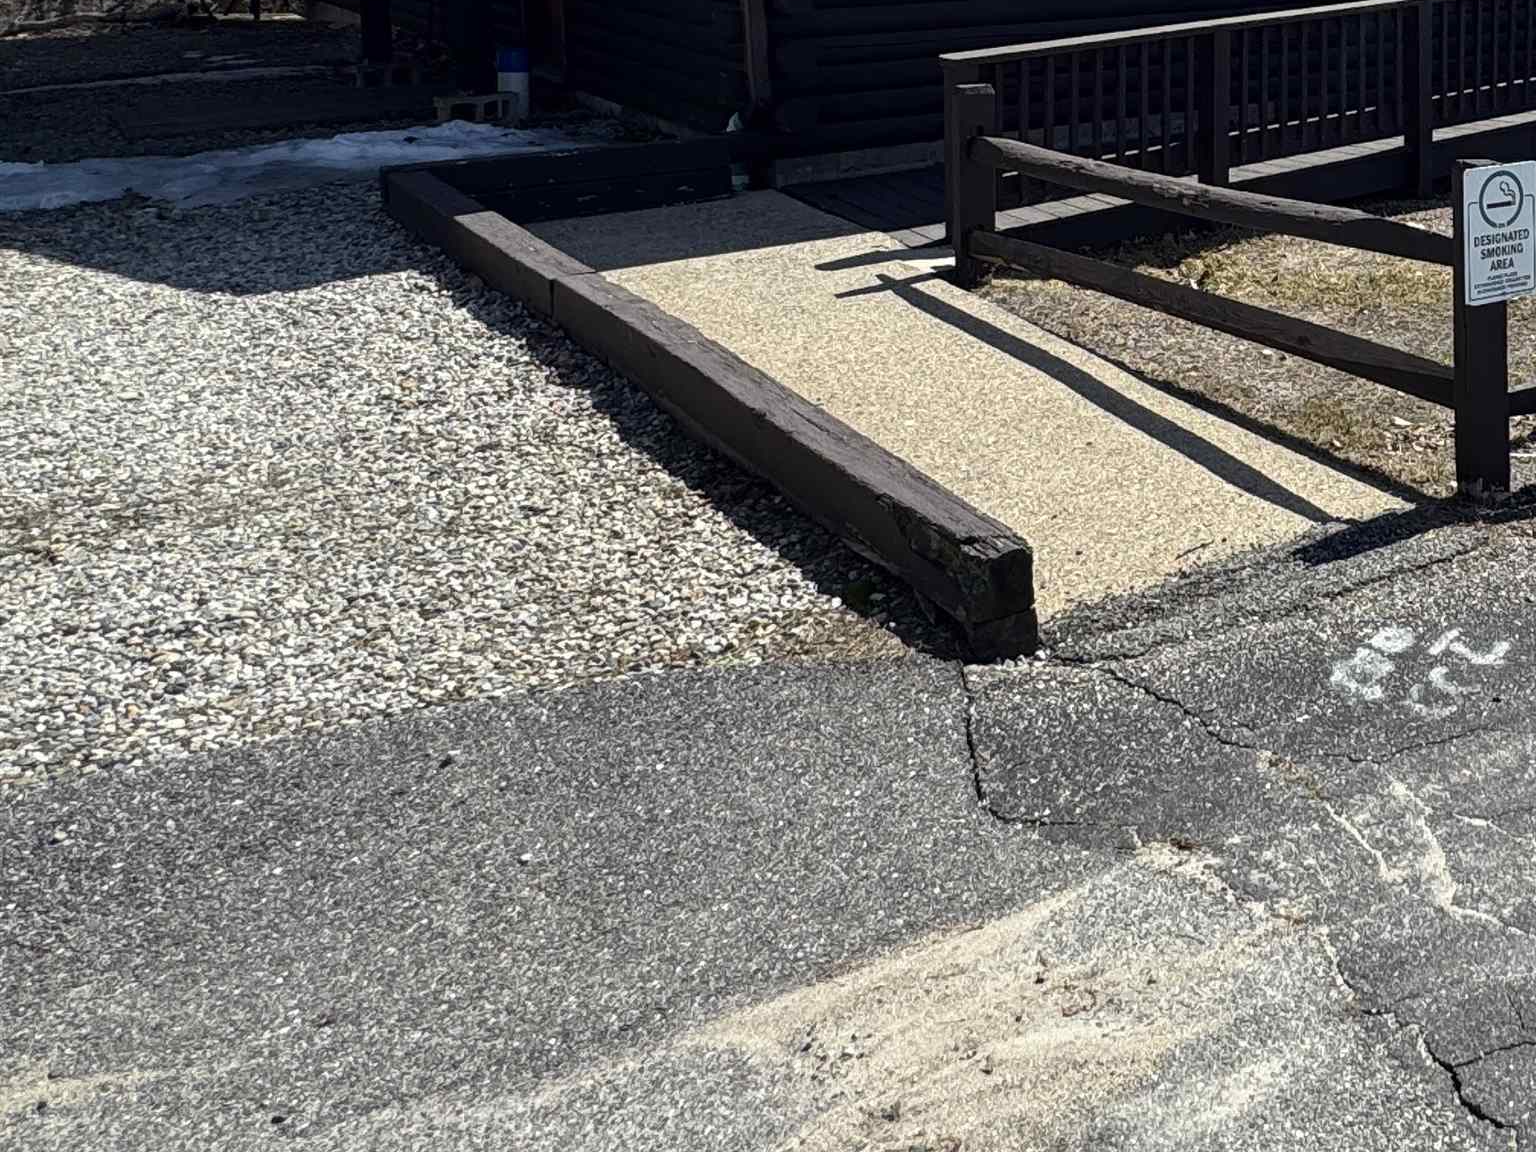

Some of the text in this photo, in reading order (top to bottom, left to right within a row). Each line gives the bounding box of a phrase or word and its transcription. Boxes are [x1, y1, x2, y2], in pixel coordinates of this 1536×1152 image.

[1473, 228, 1530, 248] DESIGNATED
[1480, 242, 1524, 260] SMOKING
[1490, 257, 1515, 271] AREA
